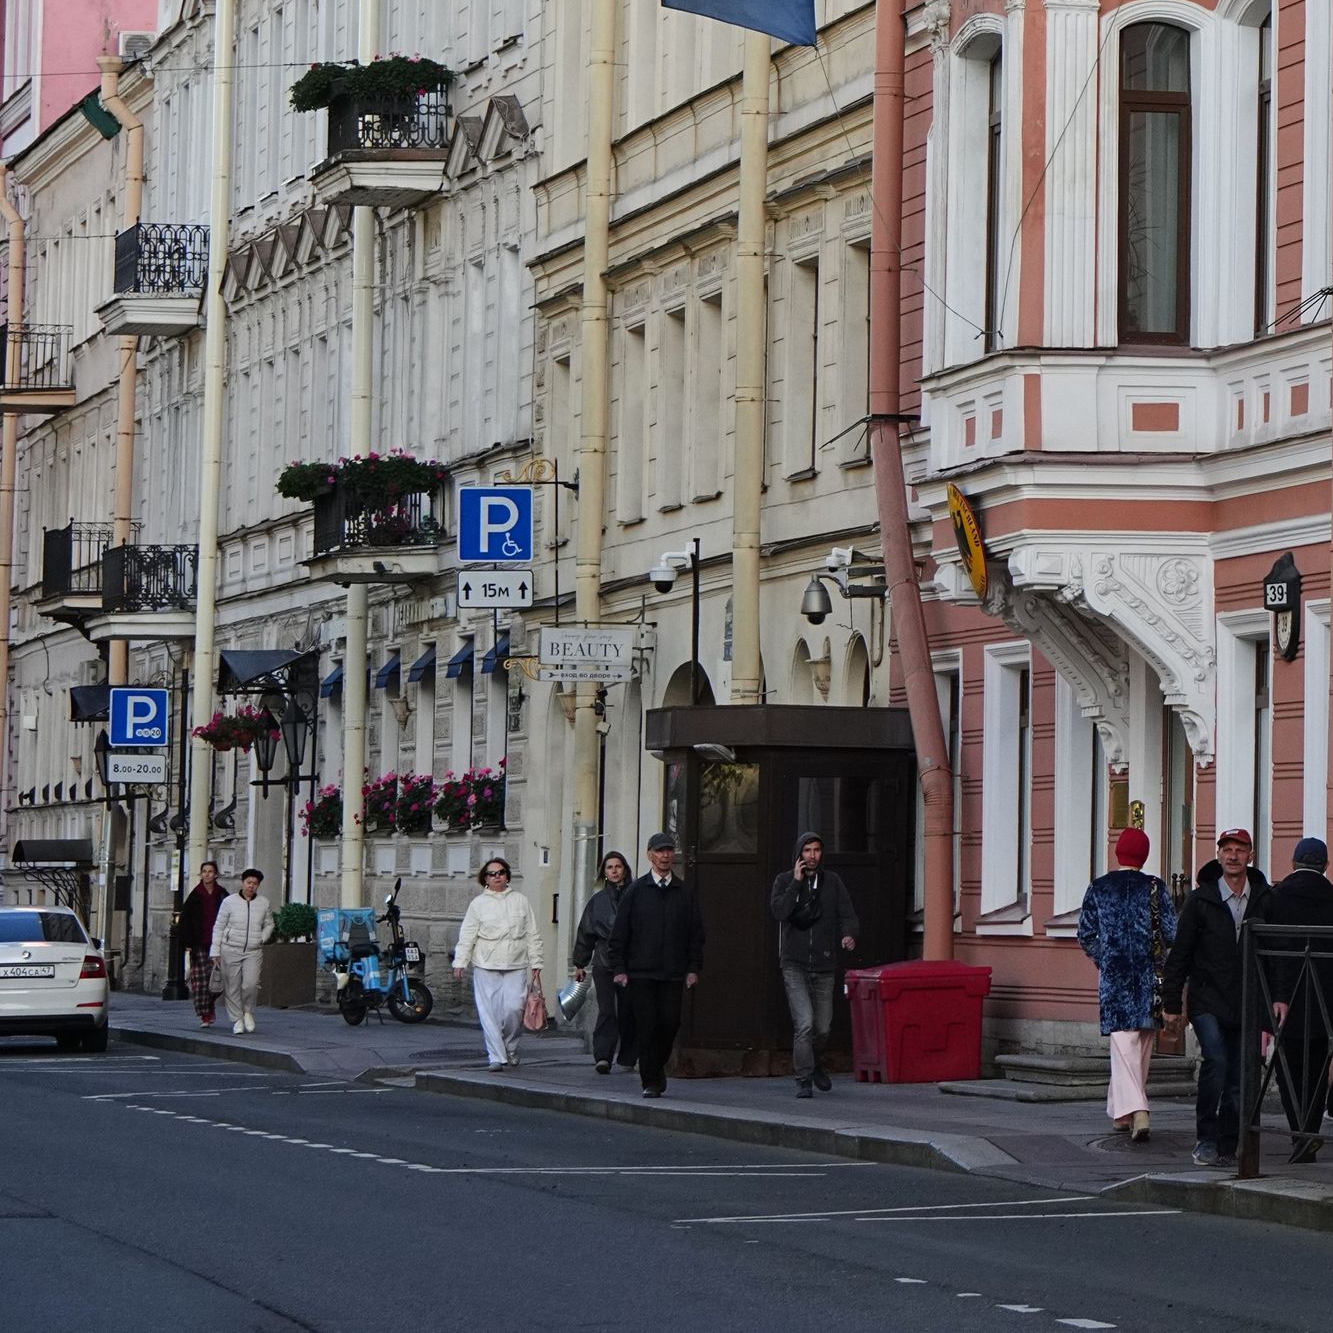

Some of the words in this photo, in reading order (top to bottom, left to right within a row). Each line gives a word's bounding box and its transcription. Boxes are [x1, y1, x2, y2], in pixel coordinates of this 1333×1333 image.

[480, 496, 519, 553] P
[1270, 585, 1284, 602] 39
[550, 641, 623, 657] BEAUTY
[126, 695, 157, 739] P
[113, 764, 162, 774] 8.00-20.00
